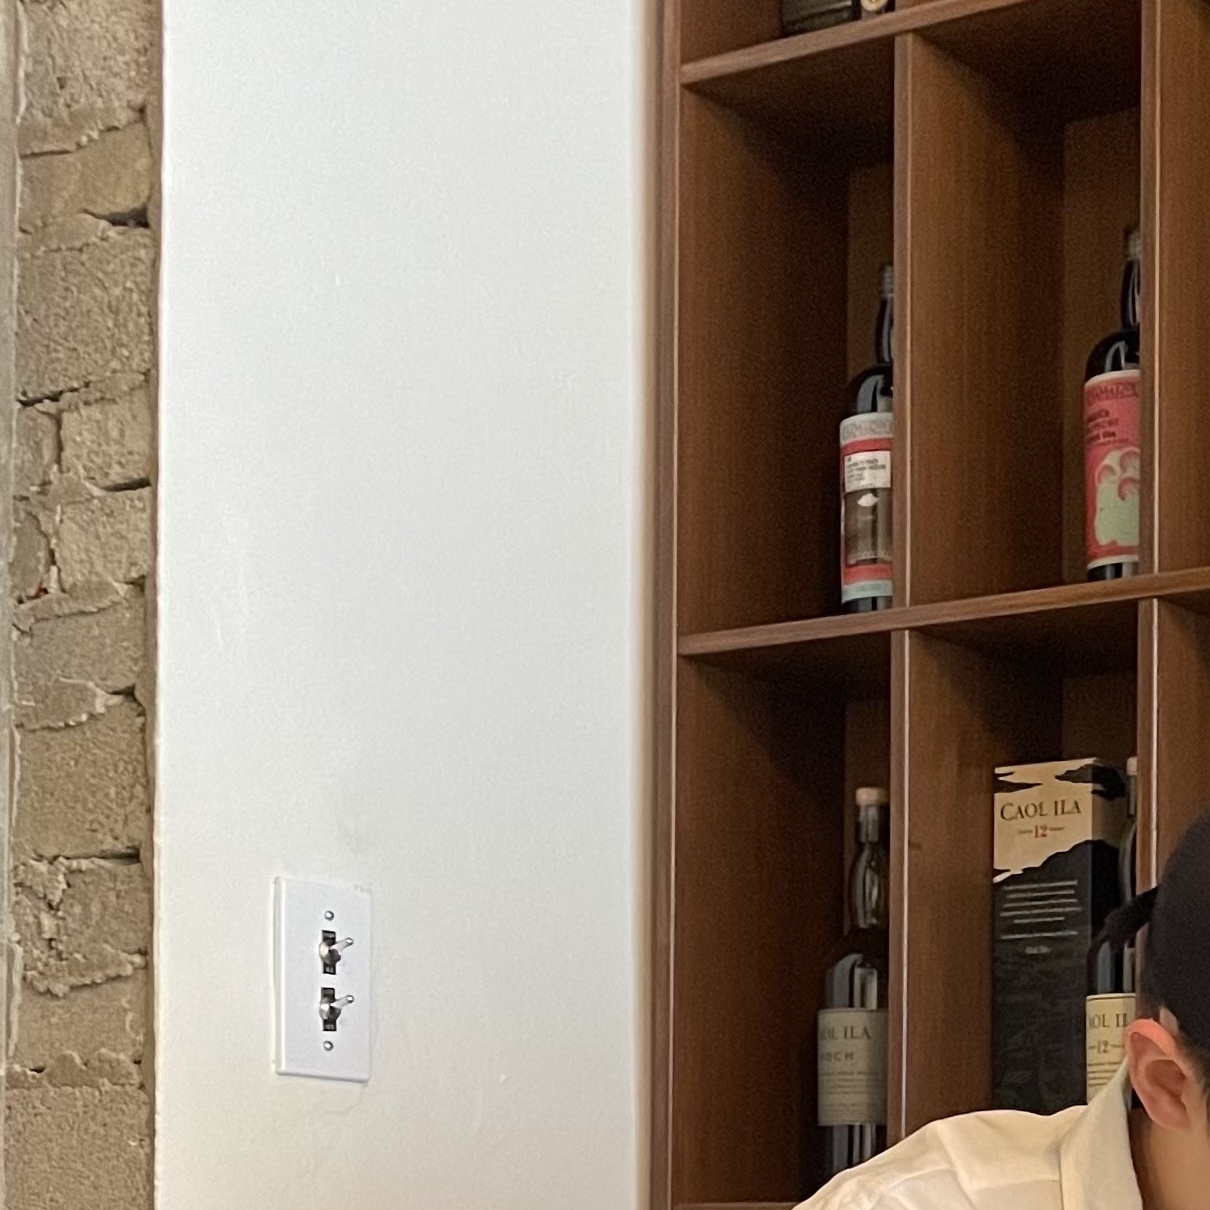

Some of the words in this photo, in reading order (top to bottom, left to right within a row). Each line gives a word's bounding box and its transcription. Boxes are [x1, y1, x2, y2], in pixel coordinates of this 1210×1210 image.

[1000, 803, 1048, 821] CAOL
[1054, 800, 1082, 816] ILA
[843, 1026, 871, 1040] ILA
